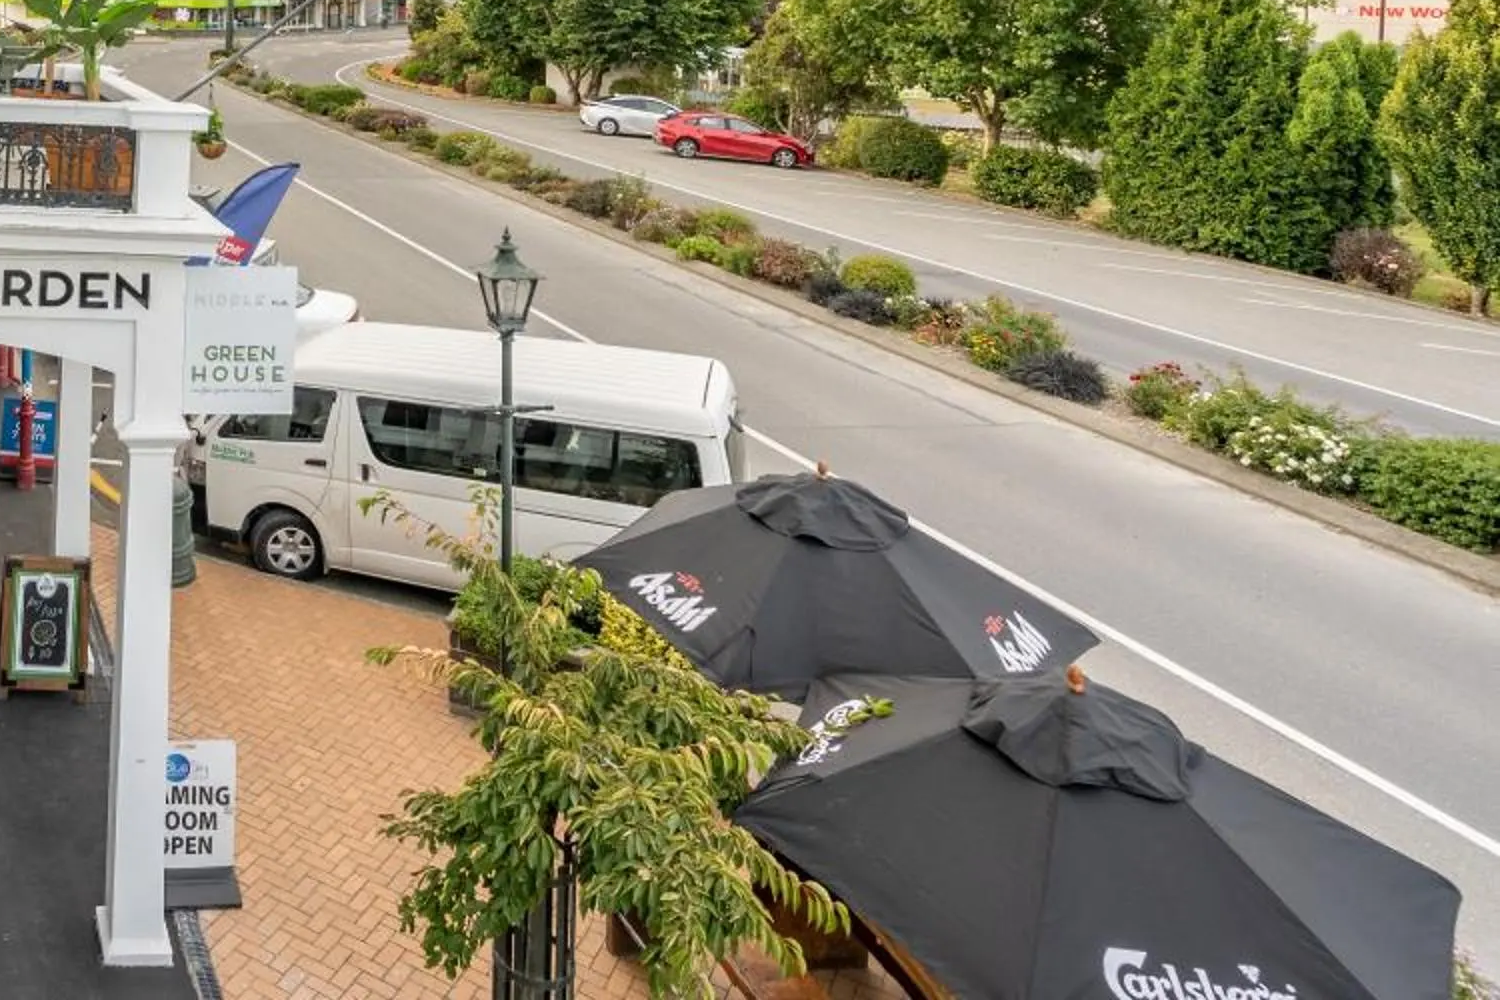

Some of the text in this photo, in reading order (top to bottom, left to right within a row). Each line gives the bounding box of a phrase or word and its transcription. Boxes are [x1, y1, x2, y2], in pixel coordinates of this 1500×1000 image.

[203, 344, 277, 362] GREEN
[191, 364, 285, 383] HOUSE
[628, 572, 718, 632] Asahi
[989, 610, 1052, 673] Asahi
[165, 785, 230, 806] MING
[164, 810, 218, 830] OOM
